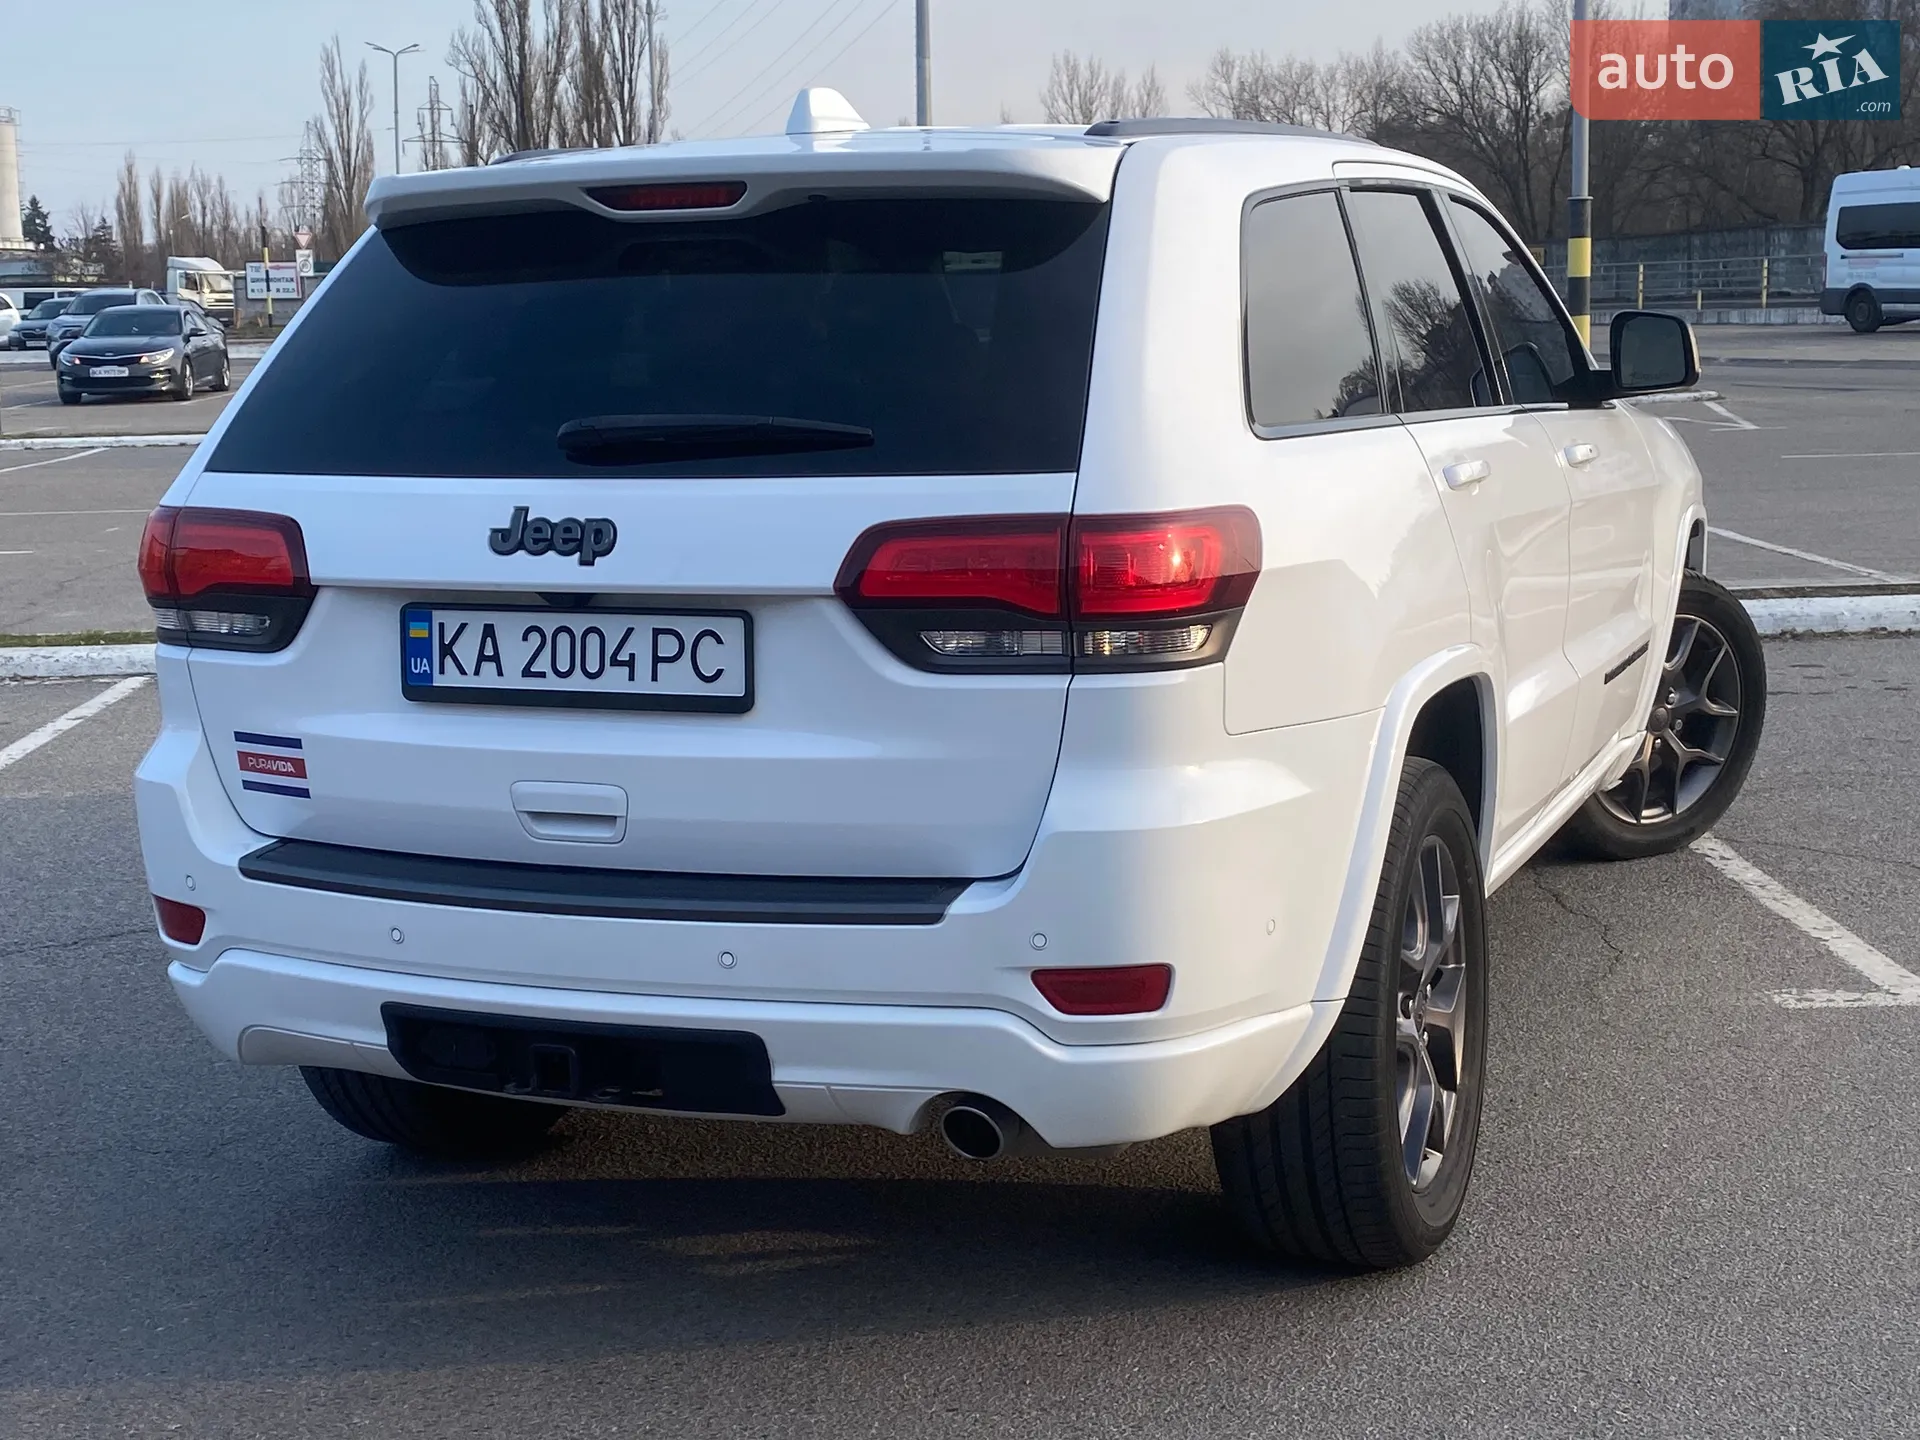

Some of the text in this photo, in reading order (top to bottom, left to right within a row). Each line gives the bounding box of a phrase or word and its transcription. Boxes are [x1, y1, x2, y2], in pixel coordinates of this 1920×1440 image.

[488, 505, 618, 566] Jeep
[411, 657, 430, 674] UA
[438, 621, 725, 684] KA 2004 PC
